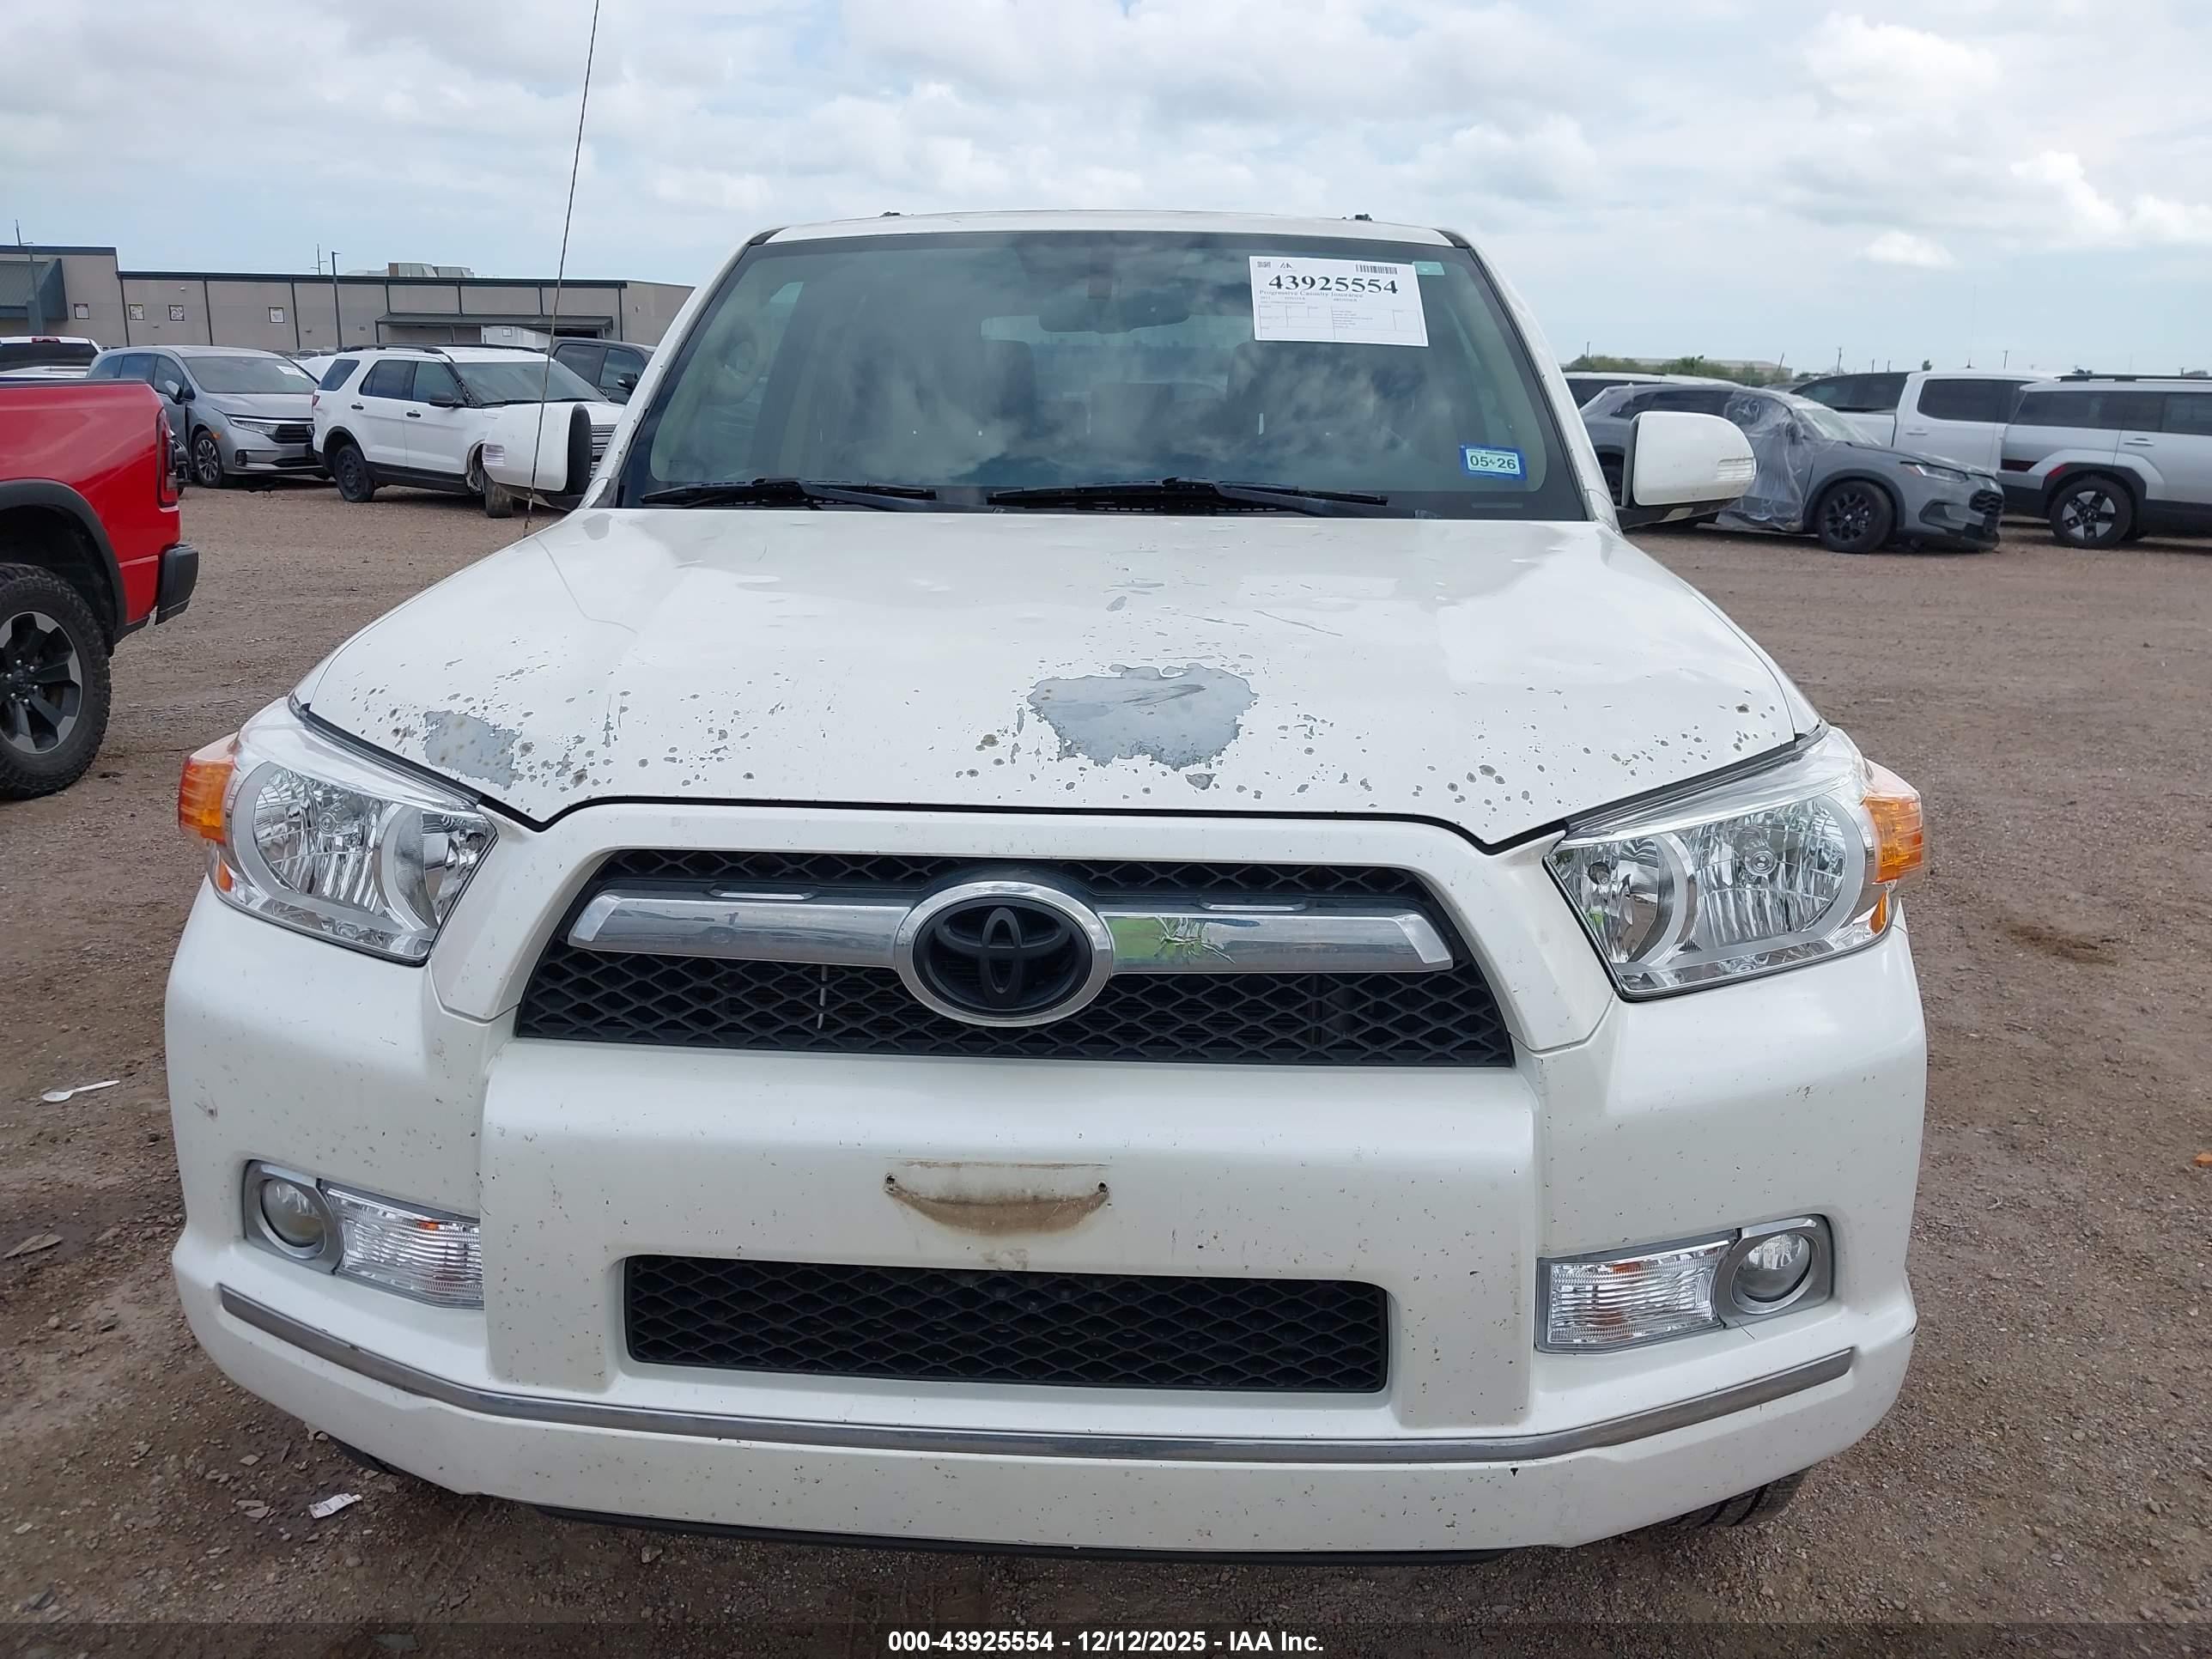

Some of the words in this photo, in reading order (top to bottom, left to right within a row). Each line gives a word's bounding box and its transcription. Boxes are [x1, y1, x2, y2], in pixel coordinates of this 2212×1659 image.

[1268, 274, 1399, 294] 43925554
[1469, 455, 1489, 467] 05
[1497, 458, 1516, 470] 26
